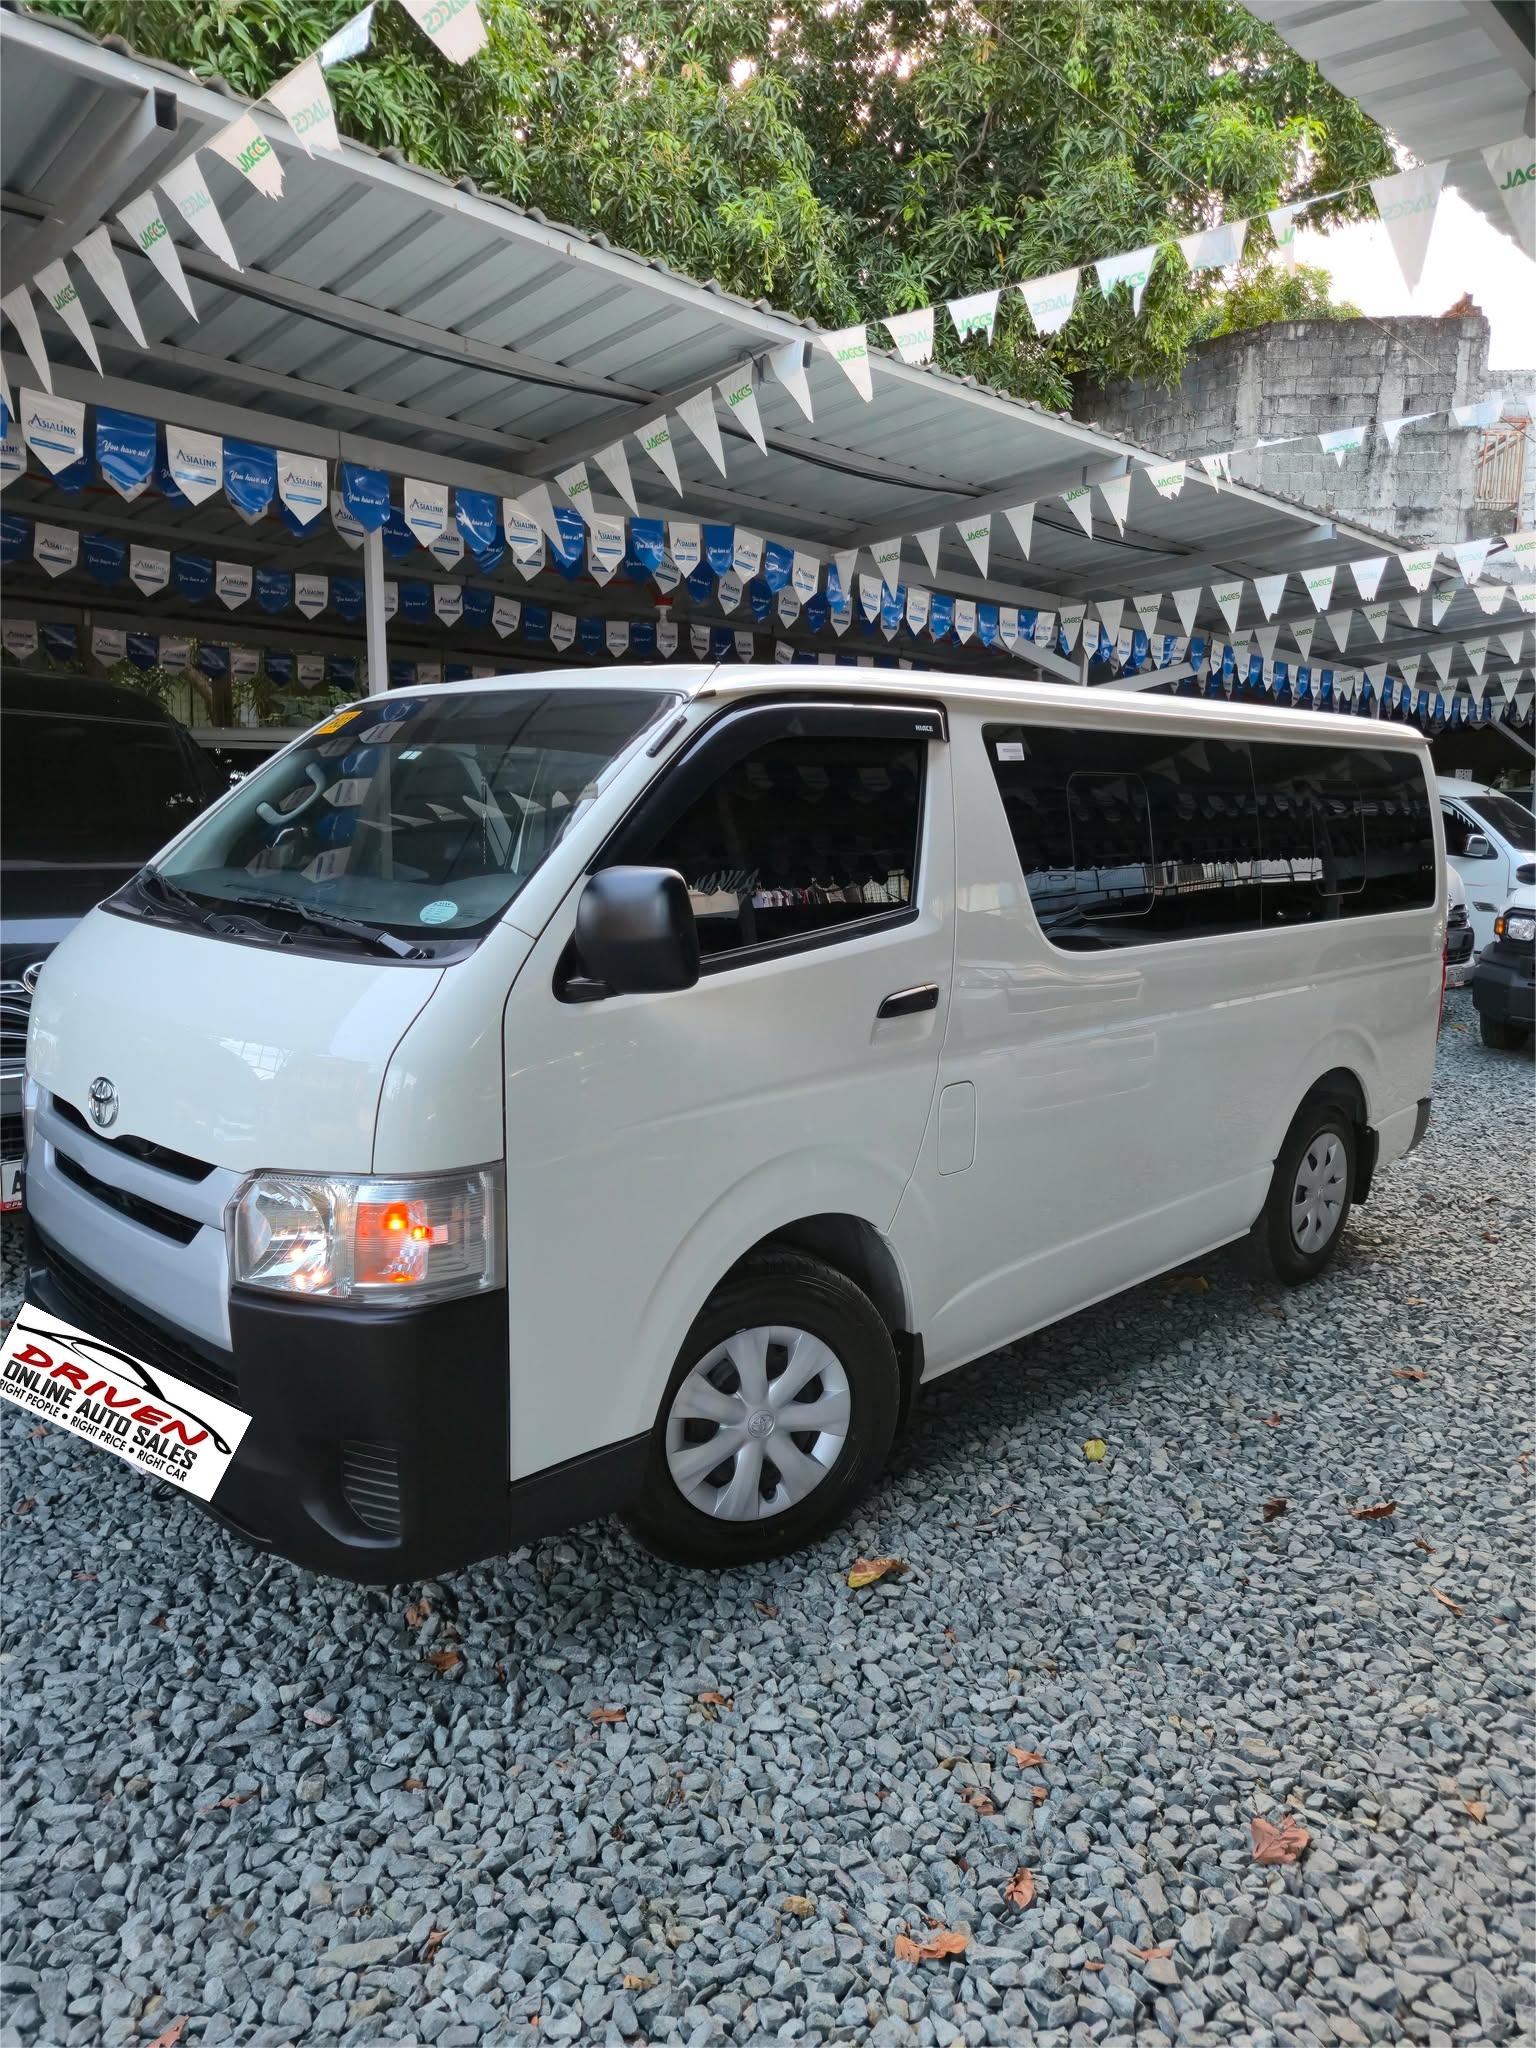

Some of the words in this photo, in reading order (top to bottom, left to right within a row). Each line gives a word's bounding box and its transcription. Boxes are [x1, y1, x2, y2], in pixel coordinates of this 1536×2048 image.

[235, 136, 272, 174] JACCS
[1500, 163, 1536, 190] JAC
[141, 218, 167, 250] JACCS
[53, 284, 77, 311] JACCS
[959, 312, 994, 333] JACCS
[837, 344, 867, 362] JACCS
[728, 383, 753, 407] JACCS
[28, 413, 77, 436] ASIALINK
[645, 430, 670, 451] JACCS
[101, 439, 118, 452] You
[120, 446, 137, 455] have
[137, 449, 150, 458] us!
[176, 449, 217, 468] ASIALINK
[229, 470, 244, 482] You
[245, 473, 260, 483] have
[260, 476, 272, 485] us!
[284, 471, 323, 489] ASIALINK
[1155, 474, 1183, 487] JACCS
[568, 480, 589, 498] JACCS
[1065, 487, 1090, 501] JACCS
[410, 498, 444, 514] ASIALINK
[335, 509, 356, 521] ASIA
[508, 517, 538, 530] ASIALINK
[965, 527, 989, 542] JACCS
[878, 552, 899, 564] JACCS
[1407, 561, 1432, 572] JACCS
[1309, 577, 1332, 589] JACCS
[1218, 591, 1240, 603] JACCS
[1138, 605, 1159, 614] JACCS
[1368, 609, 1387, 619] JACCS
[1063, 616, 1082, 624] JACCS
[1295, 628, 1312, 636] JACCS
